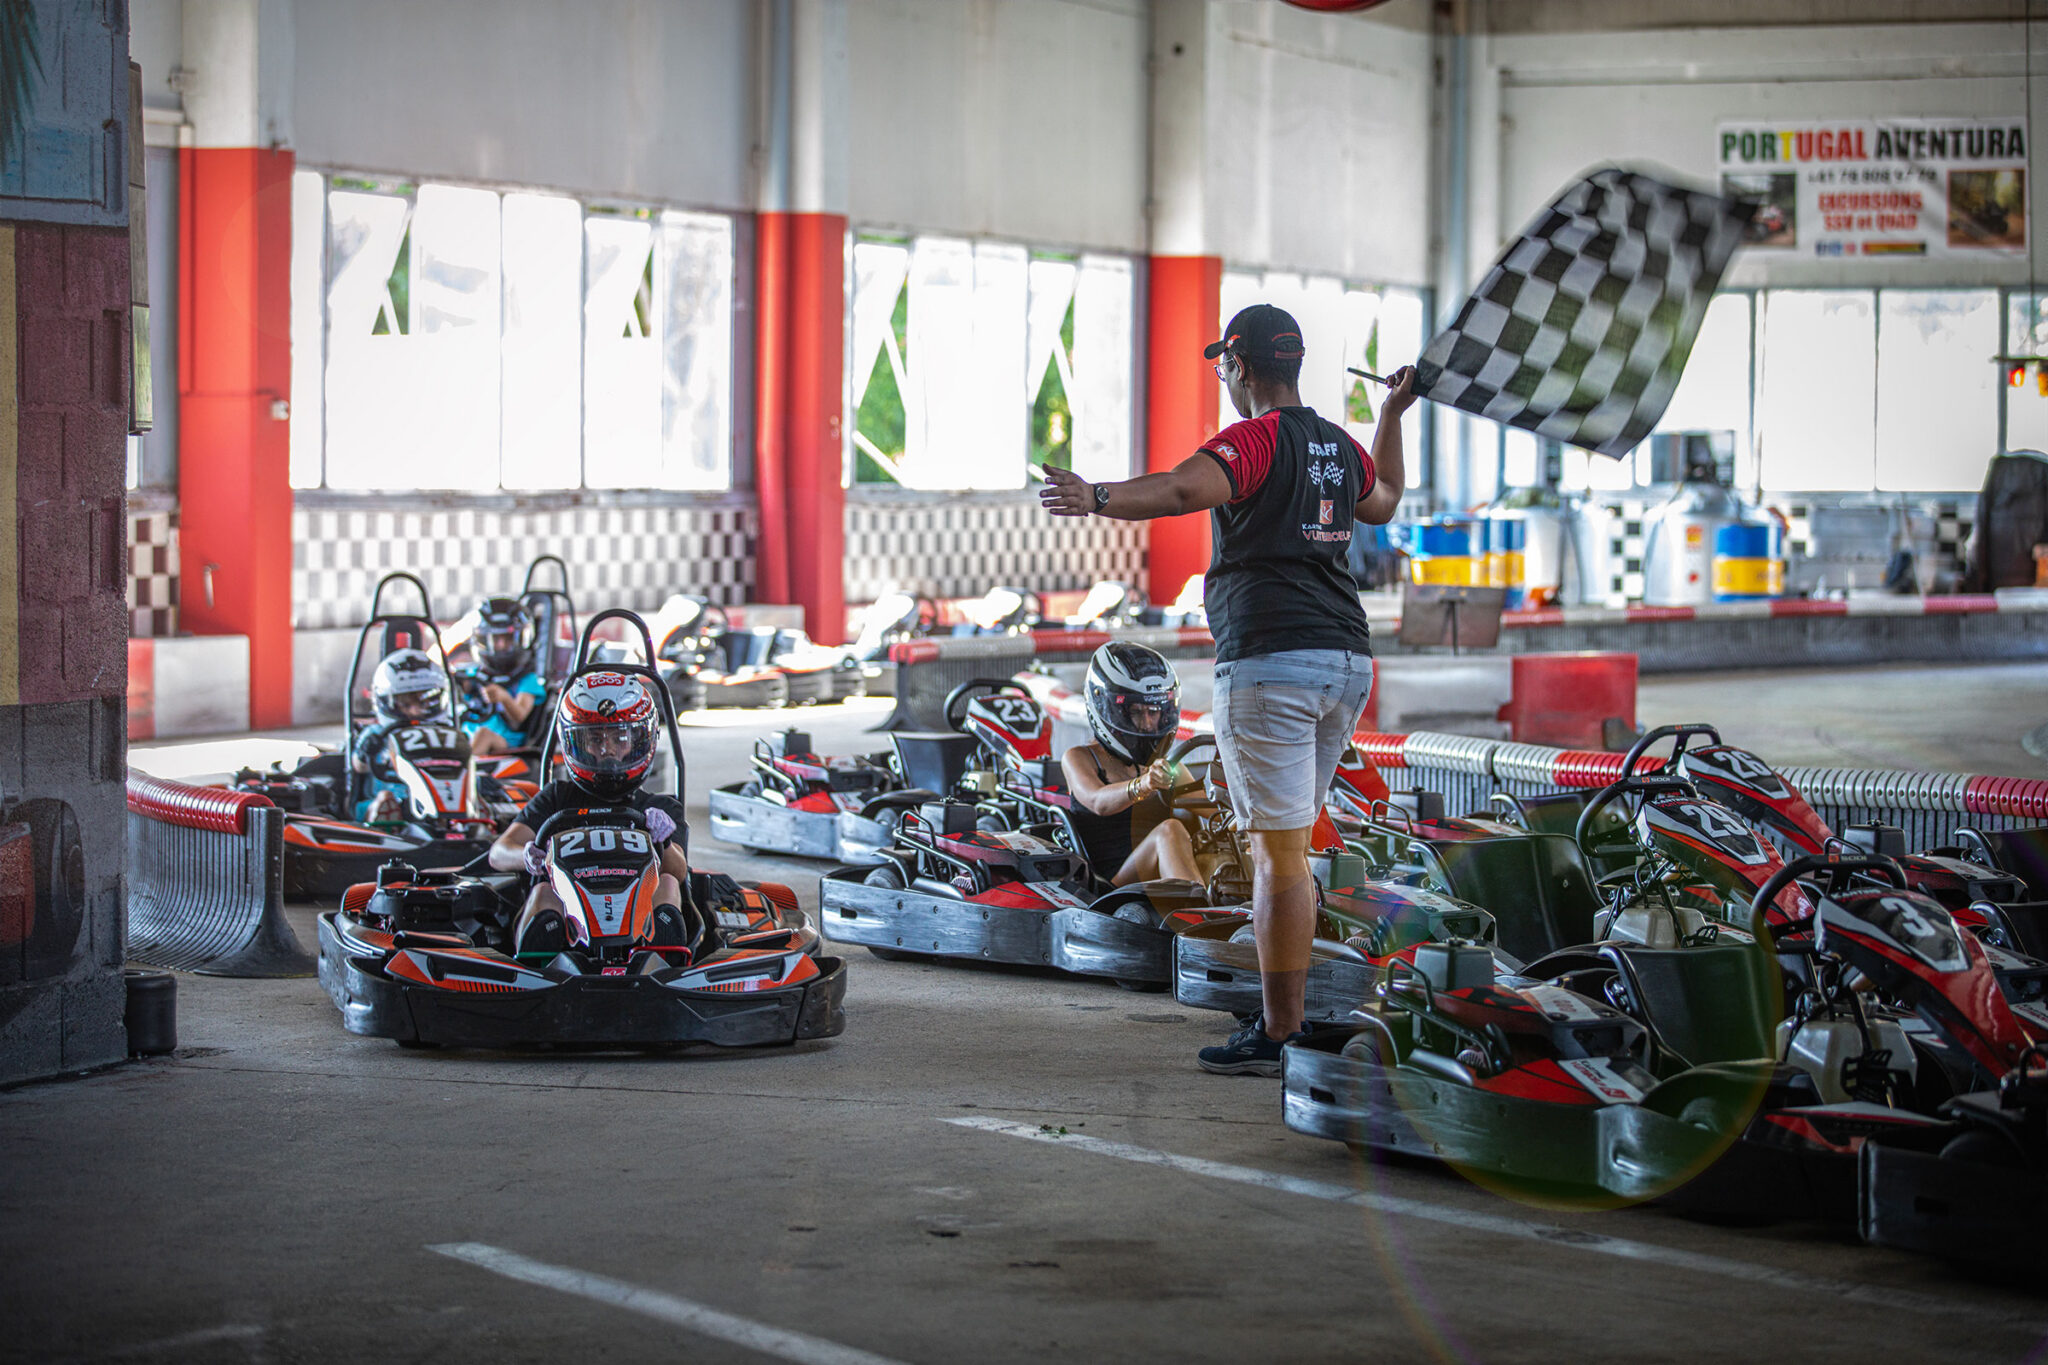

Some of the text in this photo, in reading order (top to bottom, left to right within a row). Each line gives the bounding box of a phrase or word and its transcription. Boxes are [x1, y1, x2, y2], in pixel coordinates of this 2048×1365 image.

[1721, 126, 2025, 162] PORTUGAL AVENTURA
[1818, 191, 1923, 211] EXCURSIONS
[1308, 442, 1338, 456] STAFF
[992, 698, 1038, 722] 23
[400, 728, 458, 752] 217
[1712, 750, 1773, 779] 26
[1680, 804, 1748, 838] 29
[559, 829, 650, 859] 209
[1880, 897, 1937, 937] 3
